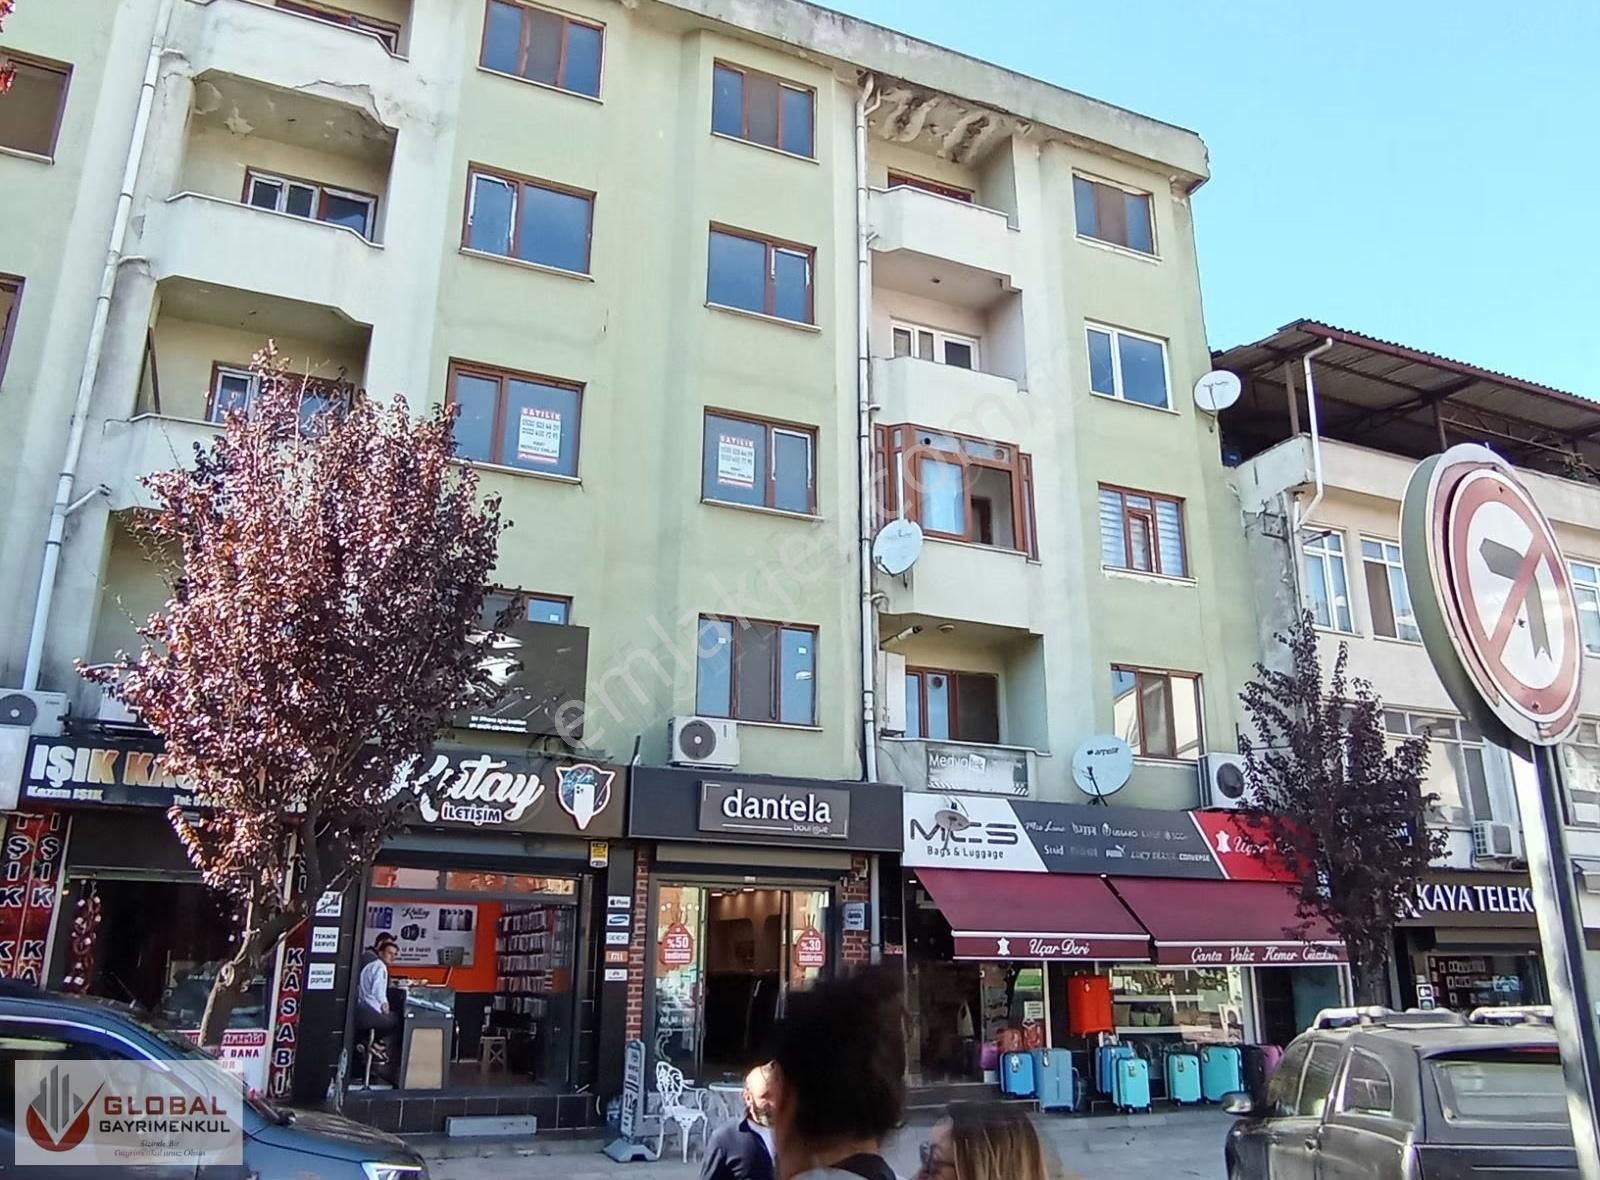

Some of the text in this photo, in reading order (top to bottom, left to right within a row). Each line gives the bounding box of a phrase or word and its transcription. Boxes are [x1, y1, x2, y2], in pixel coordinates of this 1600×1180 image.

[522, 408, 561, 420] SATILIK
[720, 436, 753, 447] SATILIK
[30, 744, 118, 788] IŞIK
[443, 801, 501, 826] İLETİŞİM
[723, 788, 832, 824] dantela
[927, 846, 1004, 859] Bags & Luggage
[1417, 884, 1537, 913] KAYA TELEK
[667, 936, 690, 949] %50
[1028, 938, 1090, 957] Uçar Deri
[1191, 946, 1223, 963] Çanta
[1230, 946, 1255, 962] Valiz
[1262, 946, 1298, 961] Kemer
[274, 947, 304, 1094] KASABI
